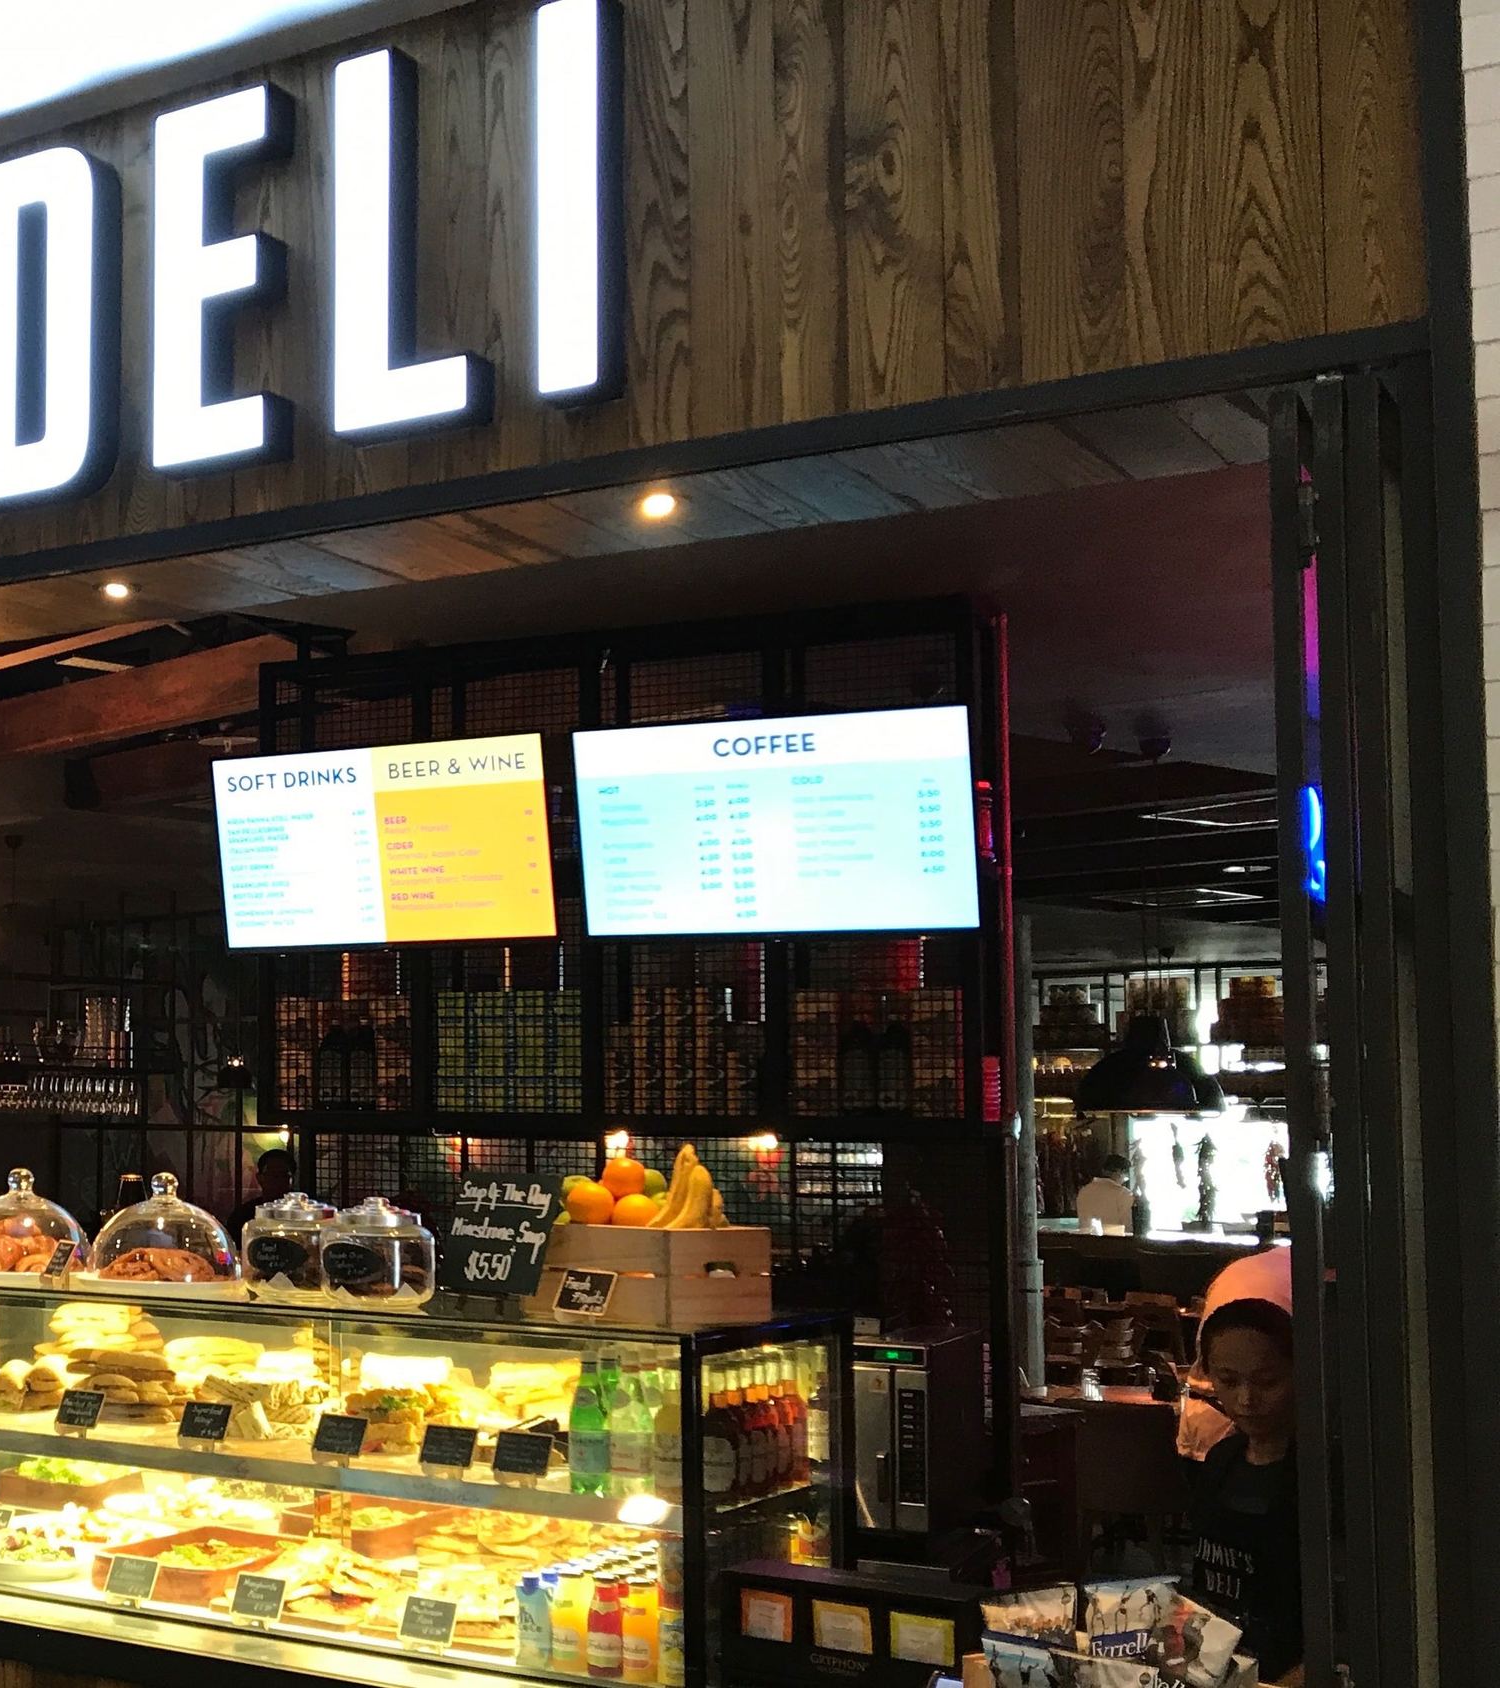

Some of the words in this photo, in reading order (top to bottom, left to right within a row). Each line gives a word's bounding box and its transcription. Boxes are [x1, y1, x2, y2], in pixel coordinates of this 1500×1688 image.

[713, 733, 816, 757] COFFEE
[388, 759, 440, 780] BEER
[447, 758, 461, 776] &
[469, 752, 526, 772] WINE
[227, 774, 277, 793] SOFT
[284, 767, 357, 788] DRINKS
[384, 815, 408, 825] BEER
[386, 841, 414, 851] CIDER
[389, 867, 418, 875] WHITE
[421, 865, 445, 874] WINE
[391, 893, 409, 901] RED
[411, 891, 435, 900] WINE
[502, 1183, 527, 1203] The
[527, 1184, 553, 1219] Day
[515, 1220, 547, 1265] Soup
[1195, 1536, 1254, 1575] JAMIE'S
[1205, 1568, 1241, 1599] DELI
[1092, 1632, 1154, 1658] Tyrrell
